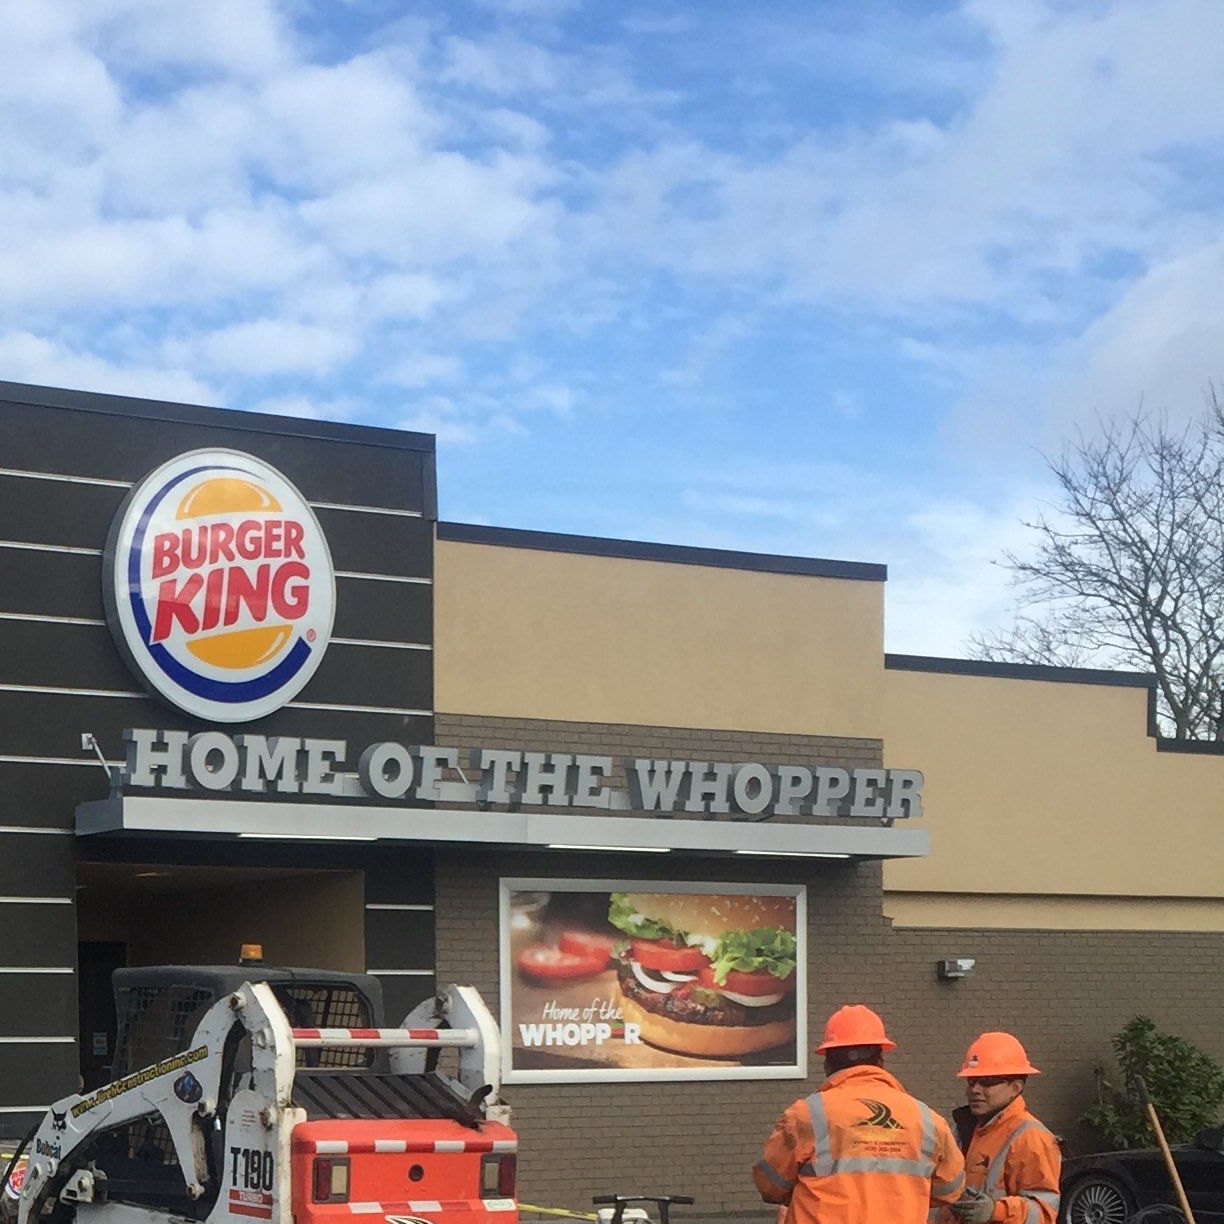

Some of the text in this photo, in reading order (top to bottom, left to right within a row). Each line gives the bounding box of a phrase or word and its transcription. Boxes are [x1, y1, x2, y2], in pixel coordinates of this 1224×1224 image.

[152, 520, 305, 579] BURGER
[153, 561, 310, 642] KING
[126, 728, 924, 818] HOME OF THE WHOPPER
[542, 997, 623, 1024] Home of the
[37, 1138, 61, 1159] Bobcat
[230, 1147, 274, 1191] T190
